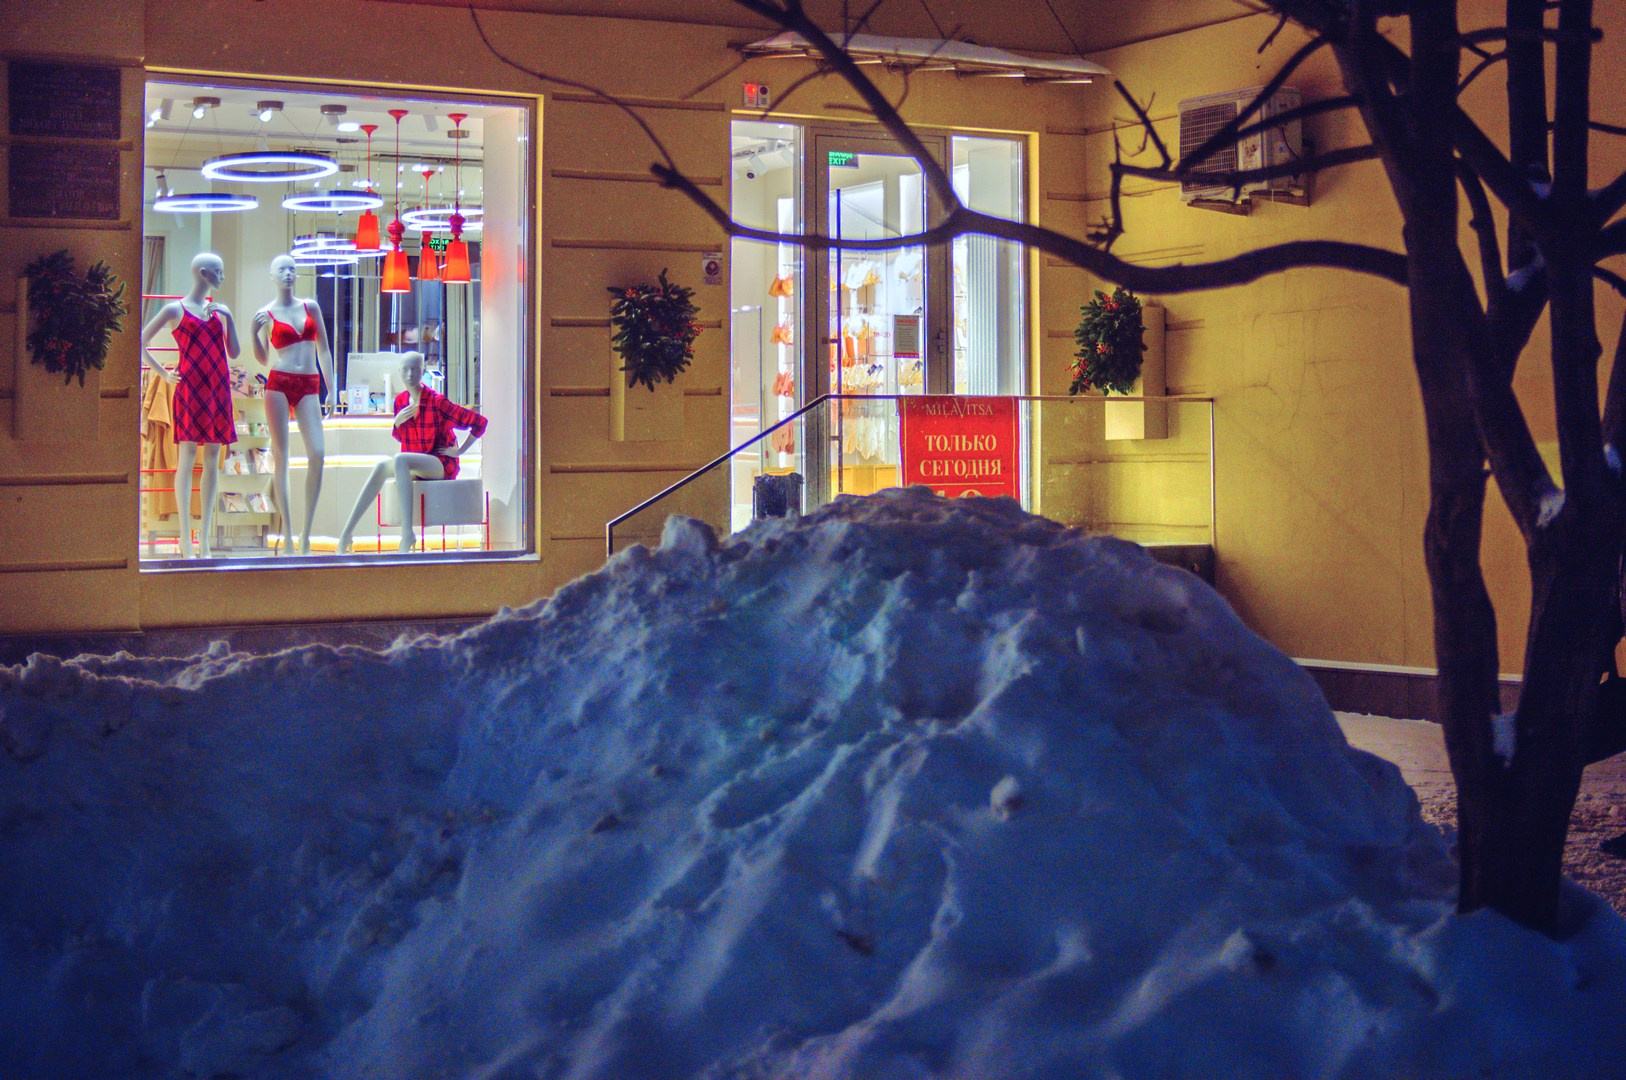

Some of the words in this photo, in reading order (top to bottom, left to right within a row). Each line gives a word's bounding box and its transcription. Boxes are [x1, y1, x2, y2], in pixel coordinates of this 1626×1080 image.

[829, 157, 847, 165] EXIT
[925, 398, 994, 418] MILAVITSA
[925, 434, 997, 452] ТОЛЬКО
[919, 459, 1002, 479] СЕГОДНЯ
